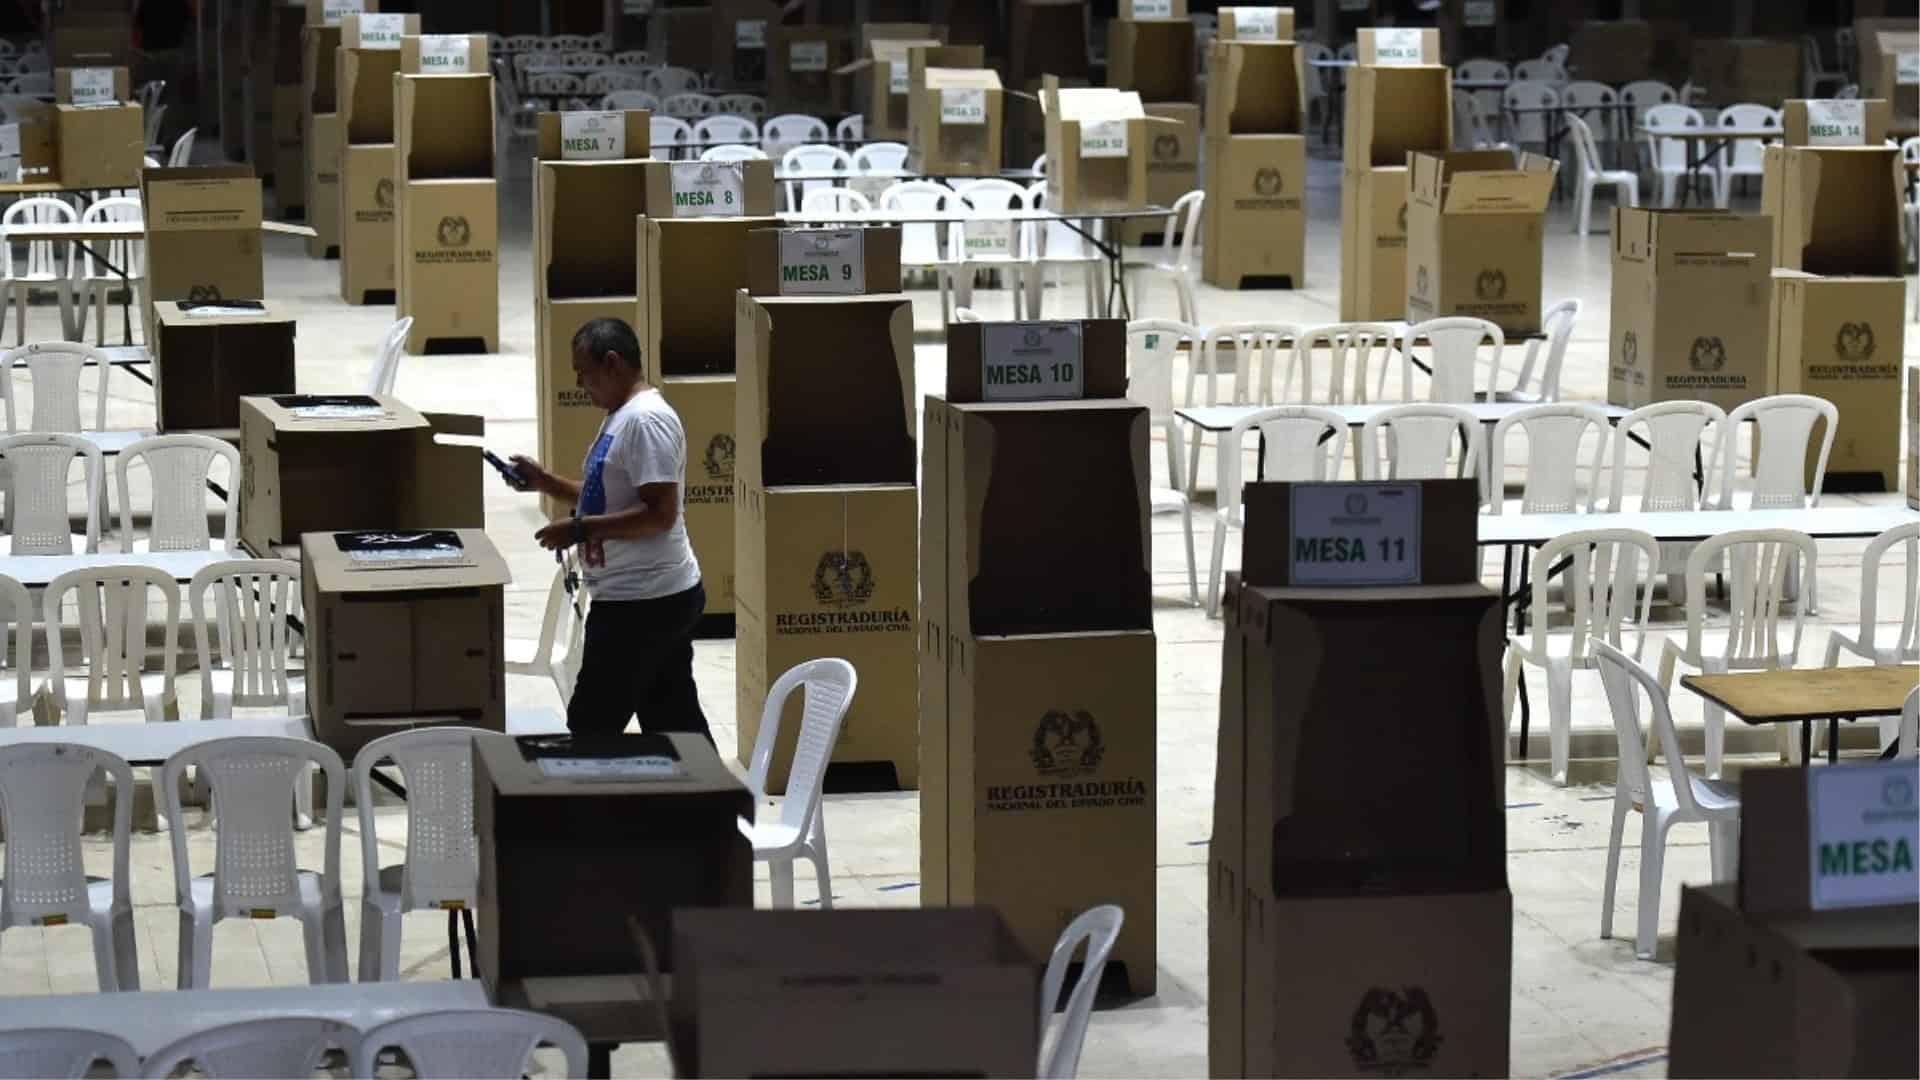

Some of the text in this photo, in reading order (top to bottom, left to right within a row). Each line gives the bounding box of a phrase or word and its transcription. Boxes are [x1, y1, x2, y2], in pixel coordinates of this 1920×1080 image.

[421, 56, 449, 66] MESA
[1809, 125, 1860, 137] MESA 14
[564, 137, 616, 151] MESA 7
[1082, 138, 1108, 149] MESA
[675, 190, 733, 206] MESA 8
[964, 238, 992, 248] MESA
[783, 263, 852, 281] MESA 9
[986, 363, 1074, 385] MESA 10
[1295, 536, 1405, 563] MESA 11
[776, 607, 912, 626] REGISTRADURÍA
[825, 625, 843, 633] DEL
[886, 623, 911, 632] CIVIL
[986, 776, 1146, 800] REGISTRADURÍA
[1819, 836, 1912, 876] MESA
